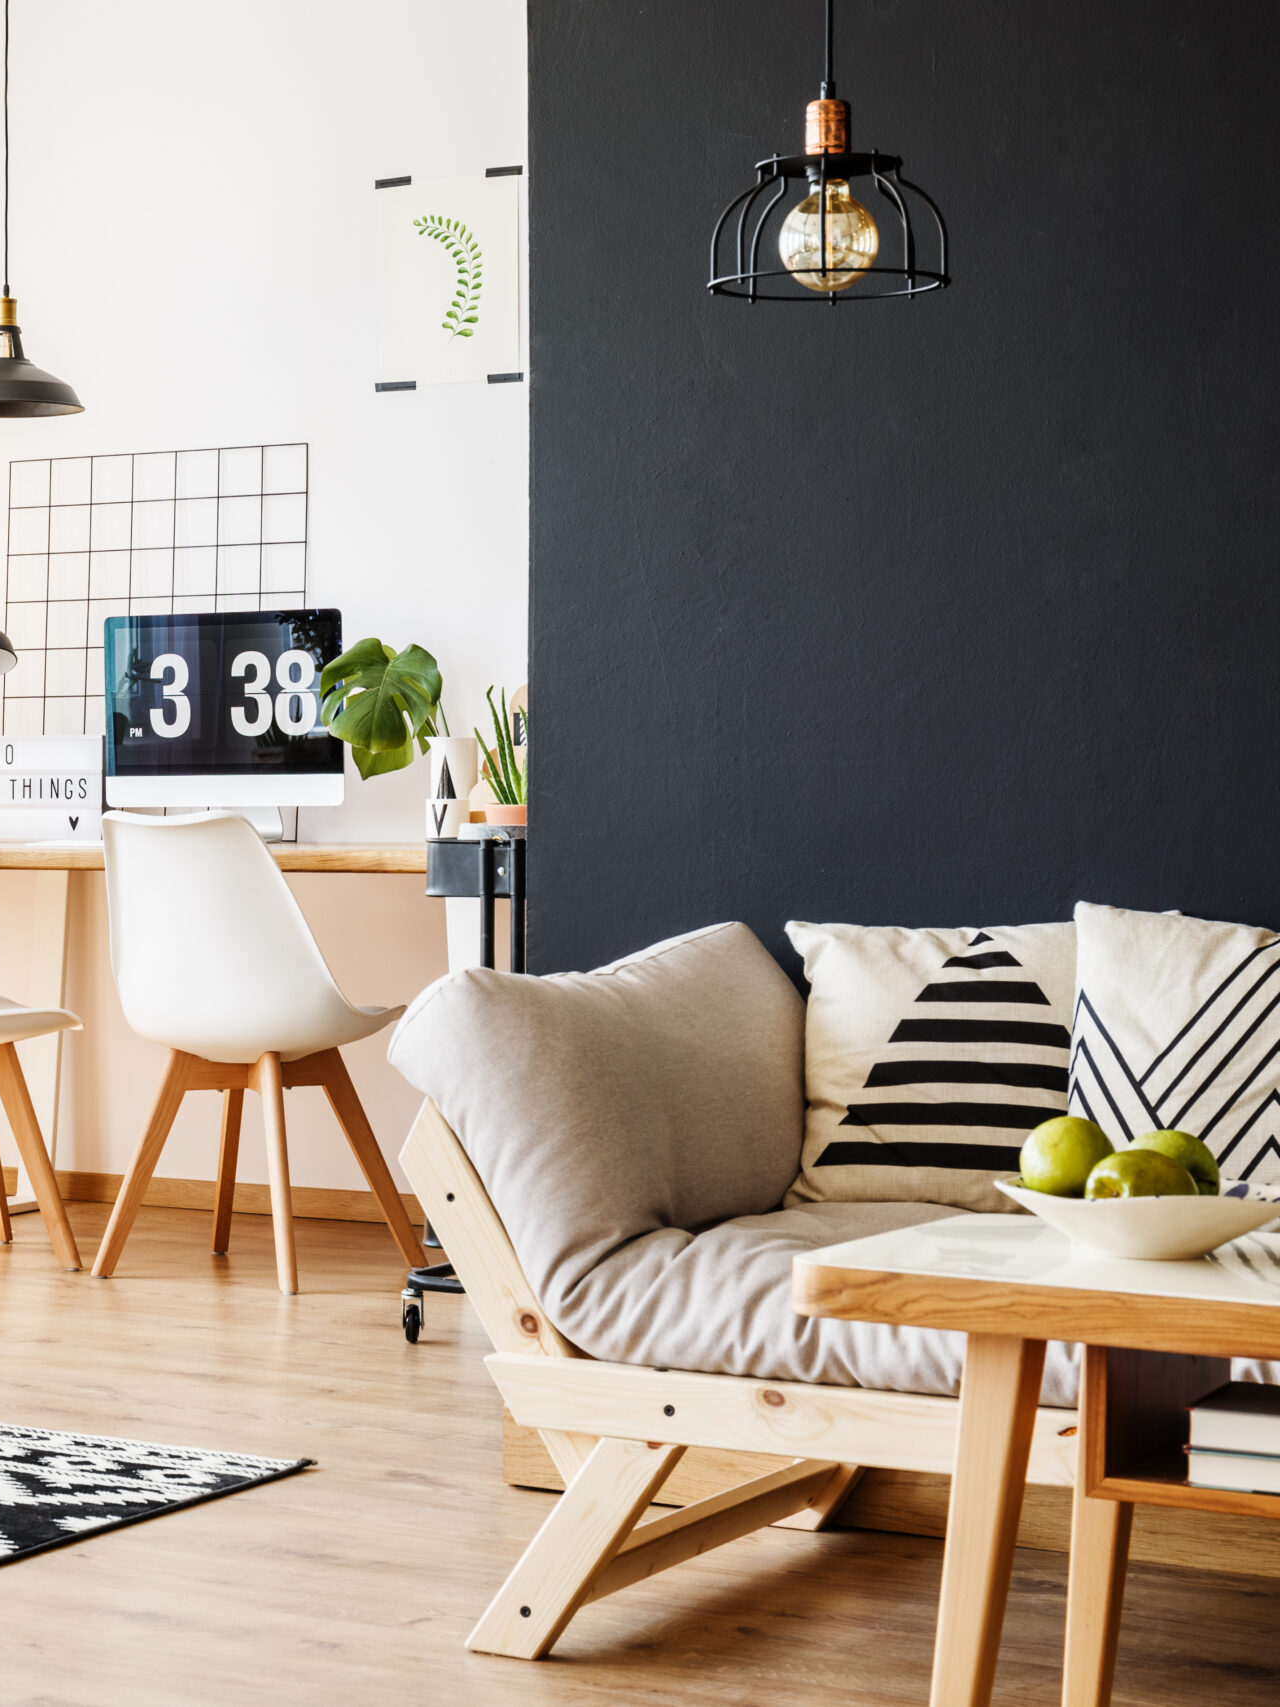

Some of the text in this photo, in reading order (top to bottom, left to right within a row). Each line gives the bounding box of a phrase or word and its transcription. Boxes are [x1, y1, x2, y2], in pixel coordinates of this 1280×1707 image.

[149, 650, 317, 739] 3 38
[129, 727, 143, 738] PM
[9, 778, 87, 800] THINGS
